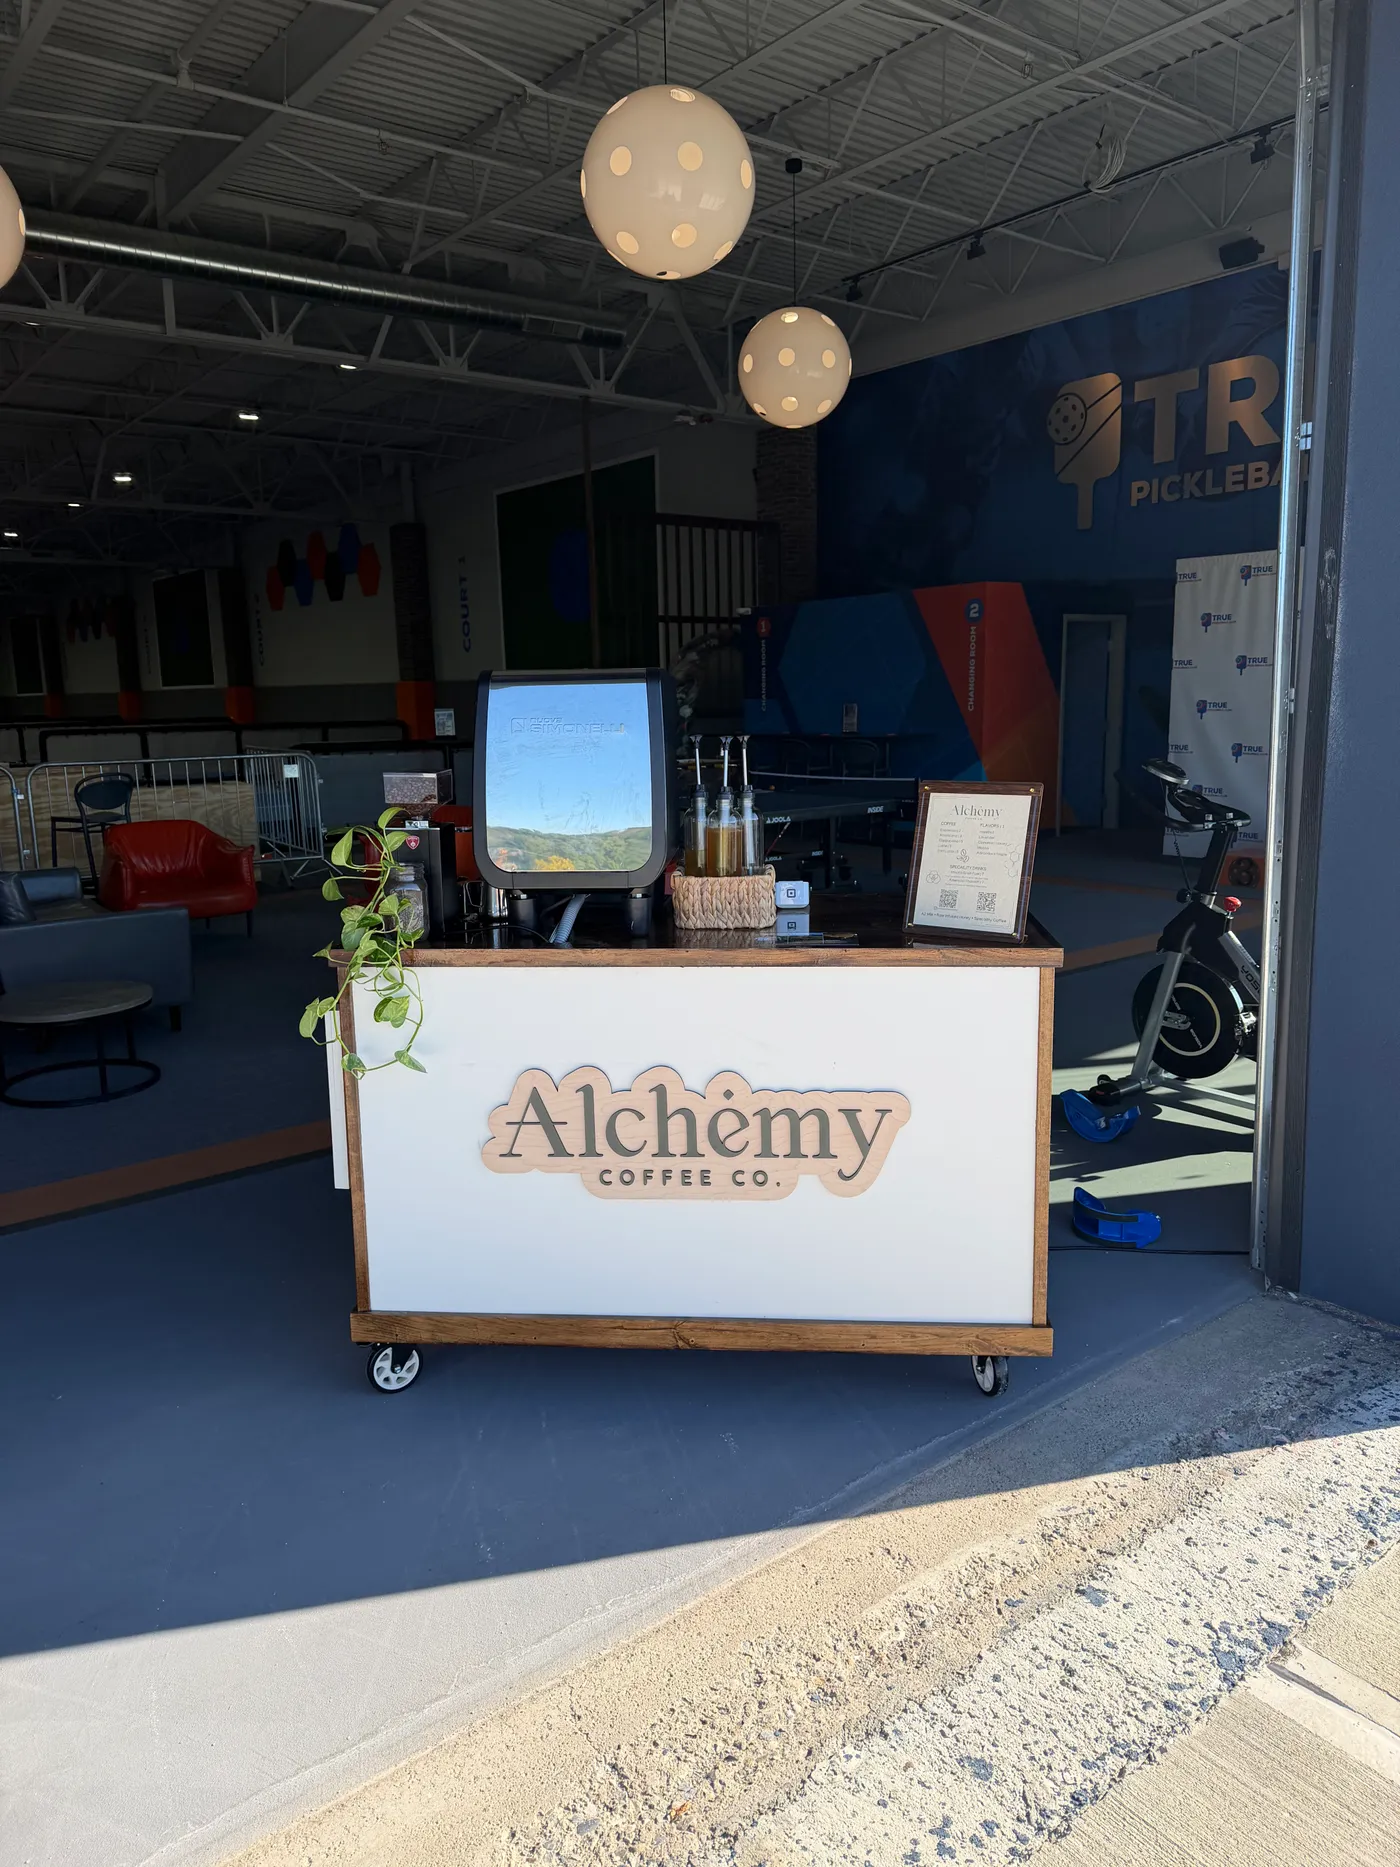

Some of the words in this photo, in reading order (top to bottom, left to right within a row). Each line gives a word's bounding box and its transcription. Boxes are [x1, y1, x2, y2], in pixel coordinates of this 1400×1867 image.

[1133, 354, 1281, 464] TR
[1252, 565, 1273, 574] TRUE
[459, 574, 471, 653] COURT
[969, 603, 980, 618] 2
[1212, 613, 1233, 621] TRUE
[760, 620, 767, 633] 1
[969, 626, 977, 657] ROOM
[1247, 656, 1268, 664] TRUE
[967, 658, 976, 712] CHANGING
[1208, 701, 1228, 709] TRUE
[1203, 787, 1223, 795] TRUE
[770, 816, 792, 824] JOOLA
[1241, 965, 1260, 993] YOS
[599, 1169, 712, 1187] COFFEE
[731, 1169, 781, 1187] CO.
